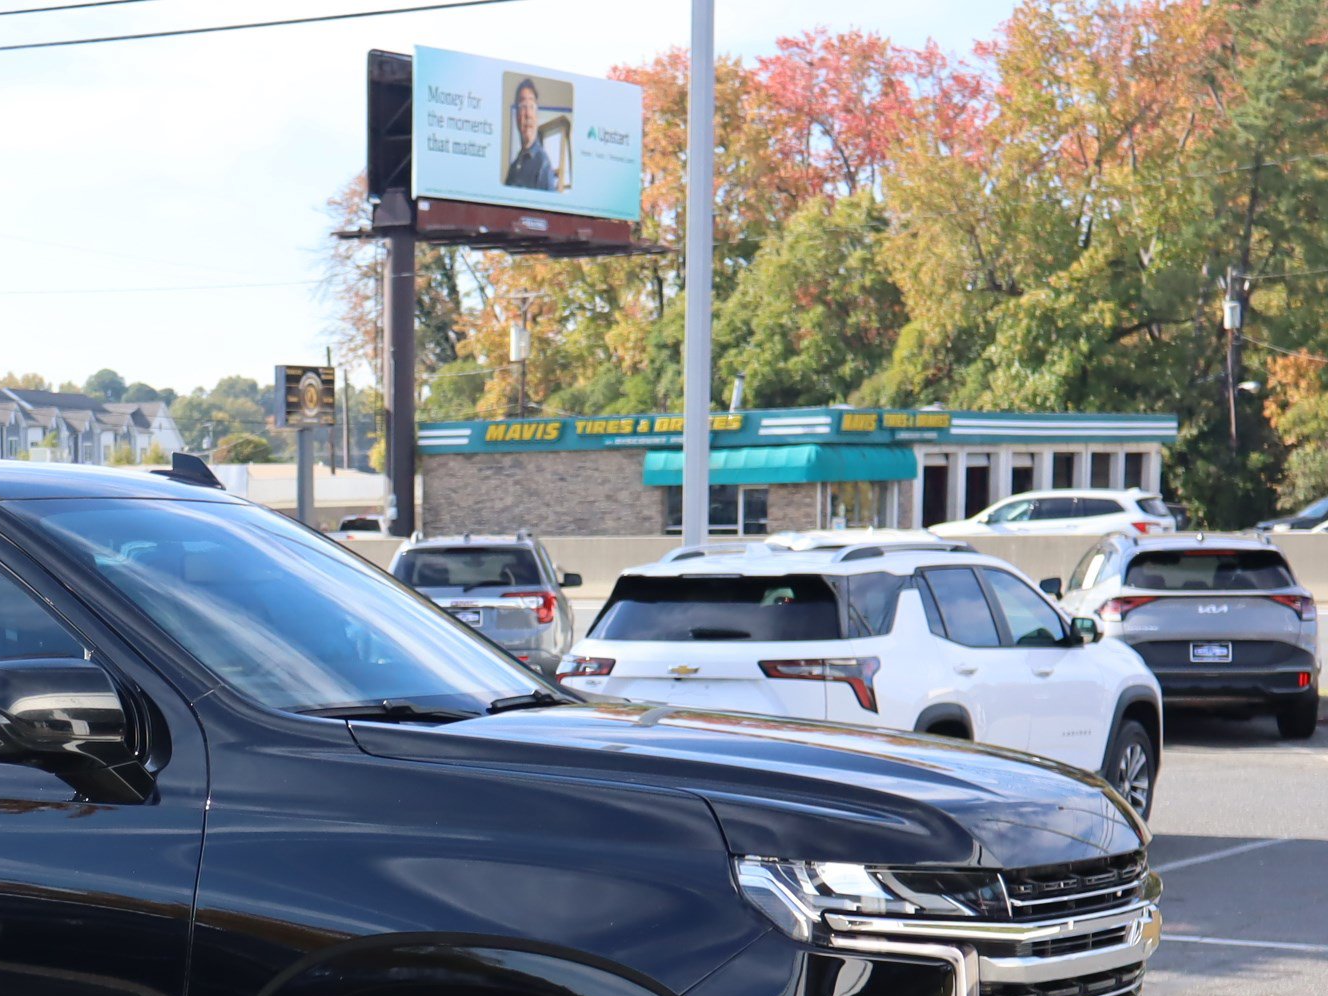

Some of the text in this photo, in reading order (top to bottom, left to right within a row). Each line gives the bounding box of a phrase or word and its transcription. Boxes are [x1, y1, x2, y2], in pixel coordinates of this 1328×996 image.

[428, 85, 481, 111] Money for
[428, 111, 493, 135] the moments
[428, 133, 449, 153] that
[598, 127, 629, 146] Upstart
[485, 415, 742, 441] MAVIS TIRES & BRES
